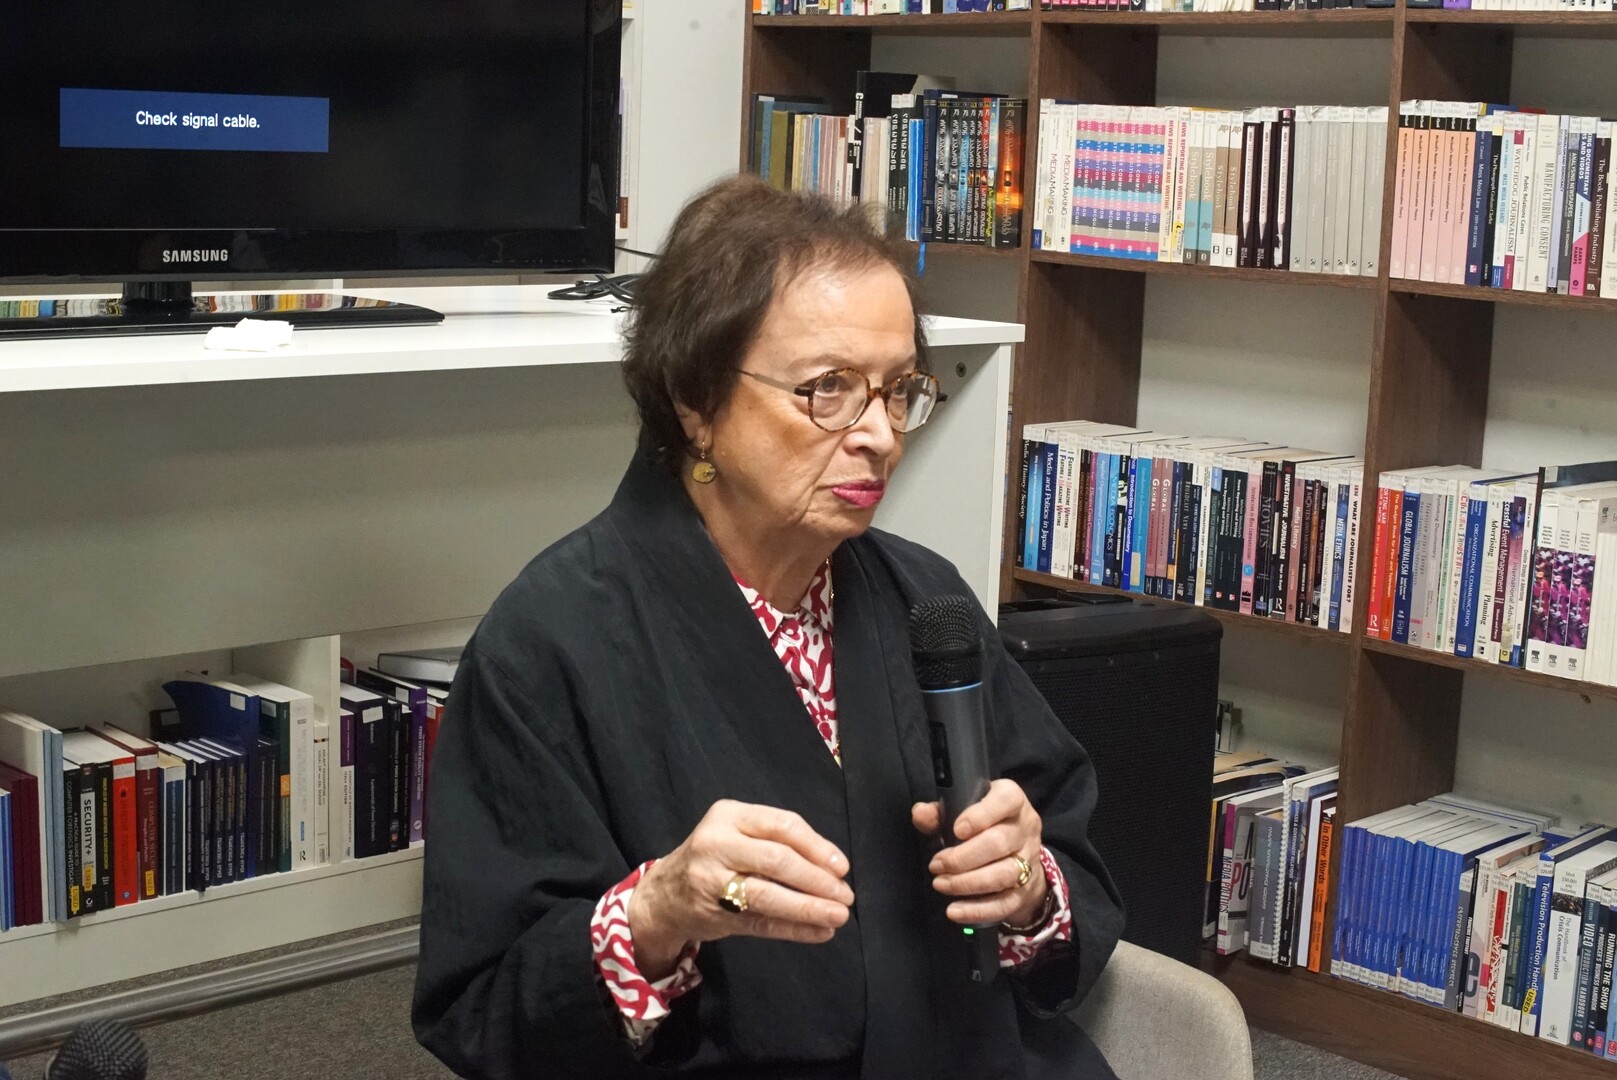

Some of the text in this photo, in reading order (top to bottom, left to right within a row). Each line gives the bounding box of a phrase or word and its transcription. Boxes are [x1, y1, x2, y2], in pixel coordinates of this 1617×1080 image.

[136, 111, 261, 129] Check signal cable.
[1048, 154, 1058, 214] MEDIAMAKING
[1061, 154, 1071, 216] MEDIAMAKING
[1188, 152, 1199, 199] Stylebook
[1203, 152, 1213, 200] Stylebook
[1215, 165, 1224, 209] Stylebook
[1228, 167, 1237, 211] Stylebook
[1490, 165, 1498, 190] Photograph
[1522, 176, 1530, 192] Public
[1567, 152, 1577, 218] ANALYSING NEWSPAPERS
[1578, 157, 1586, 179] VIDEOS
[1507, 148, 1521, 253] WATCHDOG JOURNALISM
[1520, 194, 1528, 218] Relations
[1538, 163, 1554, 260] MANUFACTURING CONSENT
[1590, 159, 1606, 264] The Book Publishing Industry
[163, 249, 229, 263] SAMSUNG
[1044, 477, 1052, 491] and
[1045, 452, 1053, 475] Media
[1066, 456, 1074, 477] FEATURE
[1019, 494, 1027, 519] Society
[1043, 493, 1051, 520] Politics
[1097, 481, 1105, 517] Organizational
[1107, 476, 1117, 550] MEDIA ECONOMICS
[1150, 479, 1160, 512] GLOBAL
[1161, 479, 1171, 512] GLOBAL
[1182, 481, 1192, 530] BROADCAST NEWS
[1095, 518, 1103, 556] Communication
[1125, 516, 1133, 552] Documentary
[1260, 496, 1272, 548] MOVIES
[1279, 474, 1291, 560] INVESTIGATIVE JOURNALISM
[1292, 506, 1302, 549] Media Literacy
[1334, 517, 1344, 559] MEDIA ETHICS
[1432, 495, 1442, 558] Rethinking Documentary
[1487, 519, 1499, 557] Advertising
[1041, 529, 1049, 550] Japan
[1347, 538, 1355, 583] JOURNALISTS
[1401, 511, 1413, 575] GLOBAL JOURNALISM
[1496, 502, 1512, 593] ccessful Event Management
[1322, 546, 1330, 594] COMMUNICATION
[1464, 524, 1480, 627] ORGANIZATIONAL COMMUNICATION
[1508, 562, 1518, 604] International
[1480, 594, 1492, 626] Planning
[84, 799, 92, 856] SECURITY+
[1320, 835, 1328, 857] Other
[1219, 856, 1233, 913] MEDIA POLITICS
[1318, 860, 1327, 884] Words
[1539, 882, 1550, 921] Television
[1535, 922, 1546, 965] Production
[1563, 928, 1571, 954] Handbook
[1583, 923, 1594, 946] VIDEO
[1596, 933, 1604, 962] PRODUCER'S
[1552, 934, 1563, 980] Communication
[1593, 964, 1601, 986] BUSINESS
[1600, 933, 1616, 1010] RUNNING THE SHOW
[1522, 991, 1535, 1013] USED
[1577, 949, 1590, 1018] PRODUCTION HANDBOOK
[1590, 987, 1599, 1011] HANDBOOK
